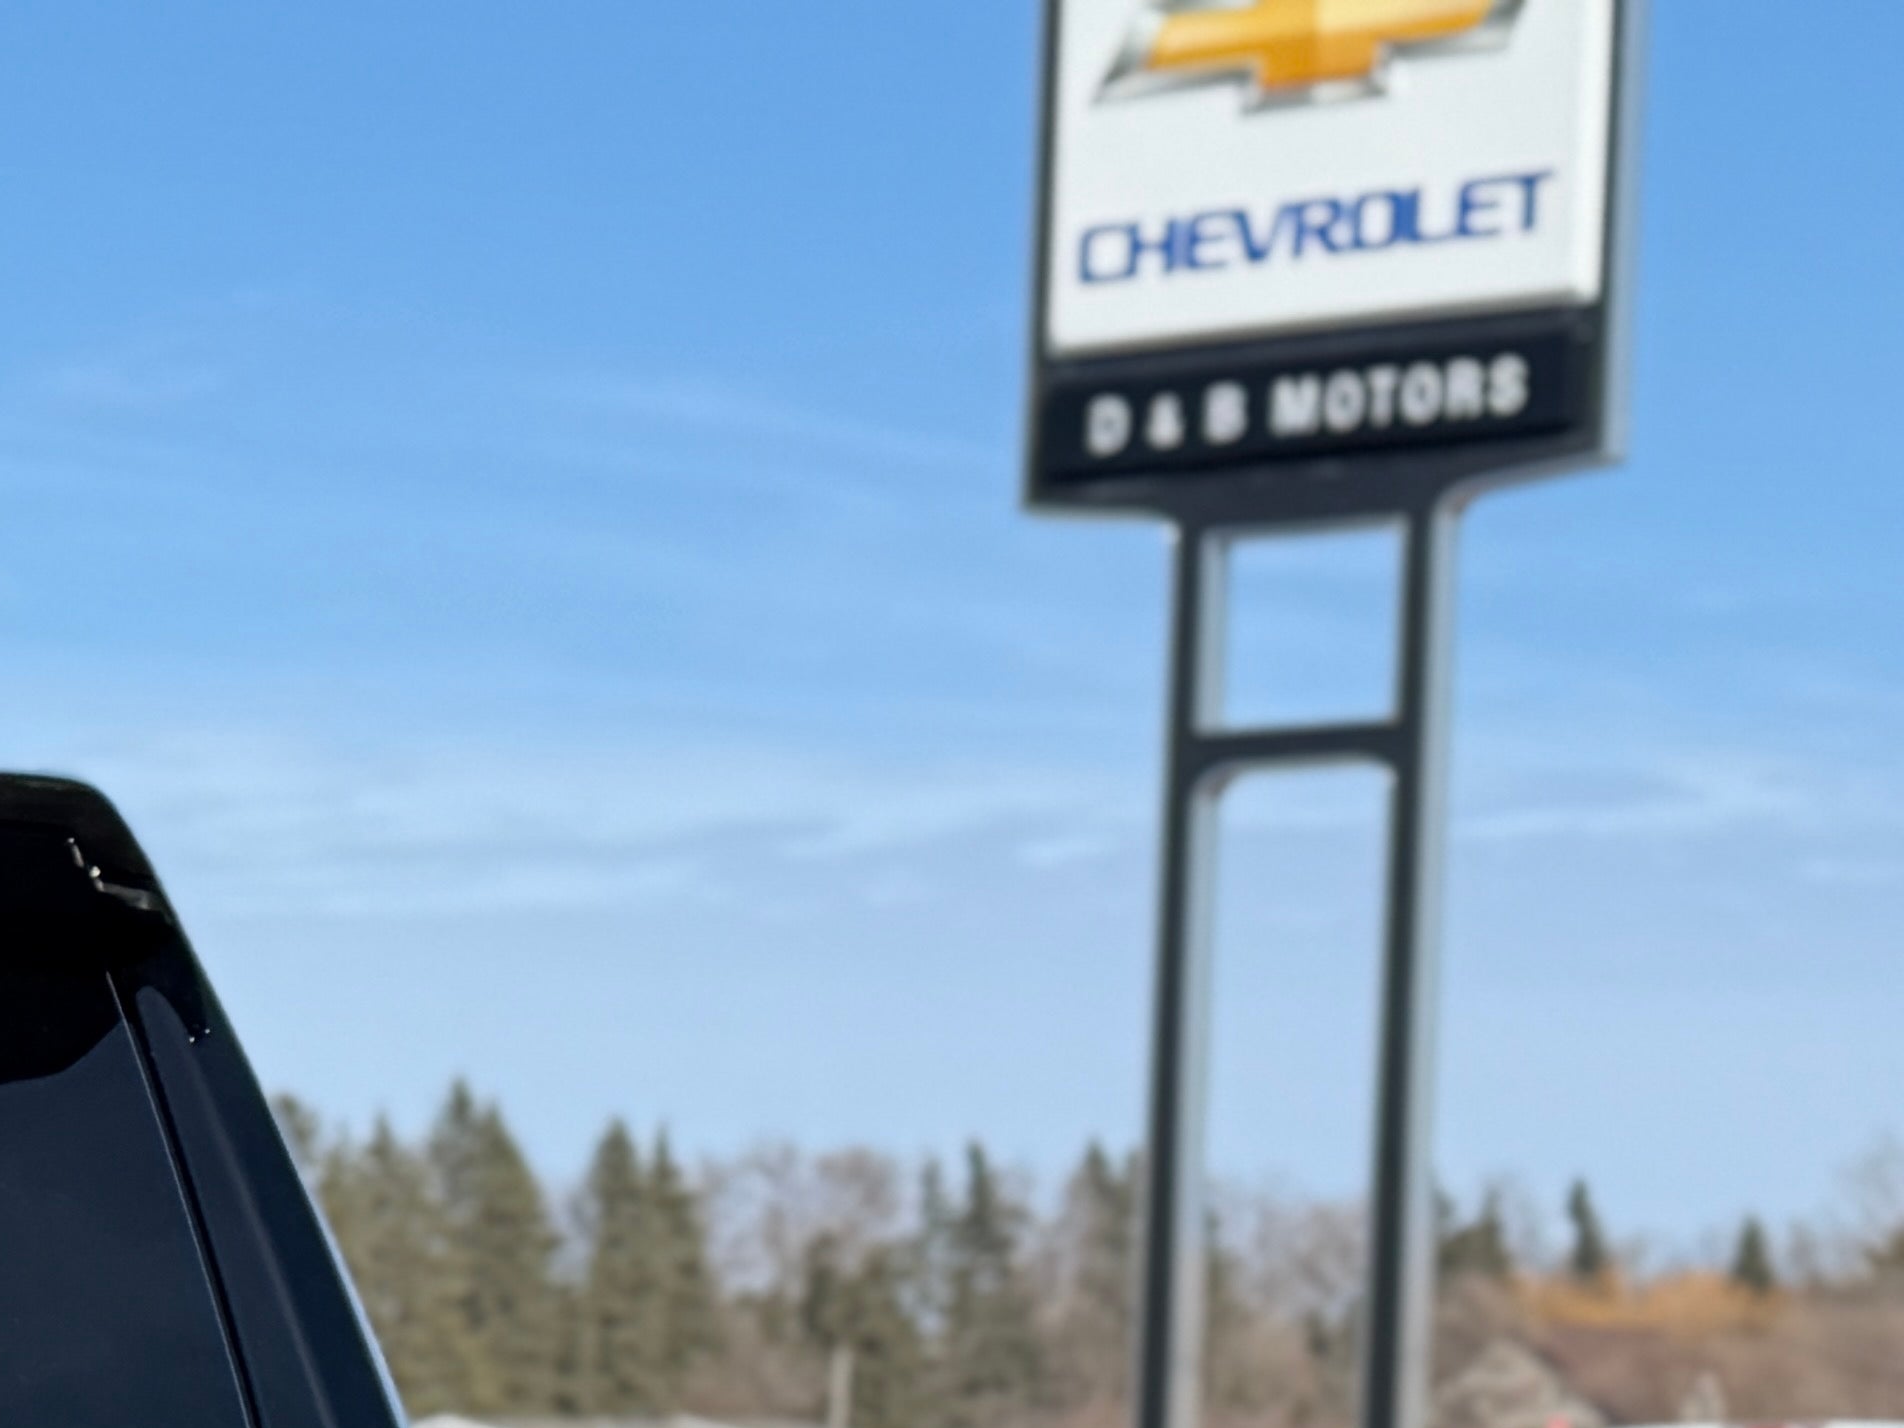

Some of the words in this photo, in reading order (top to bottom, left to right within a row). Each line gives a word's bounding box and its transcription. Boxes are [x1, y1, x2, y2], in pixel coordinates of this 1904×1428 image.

[1078, 169, 1555, 284] CHEVROLET
[1085, 394, 1132, 456] D
[1202, 382, 1248, 444] B
[1269, 352, 1531, 438] MOTORS
